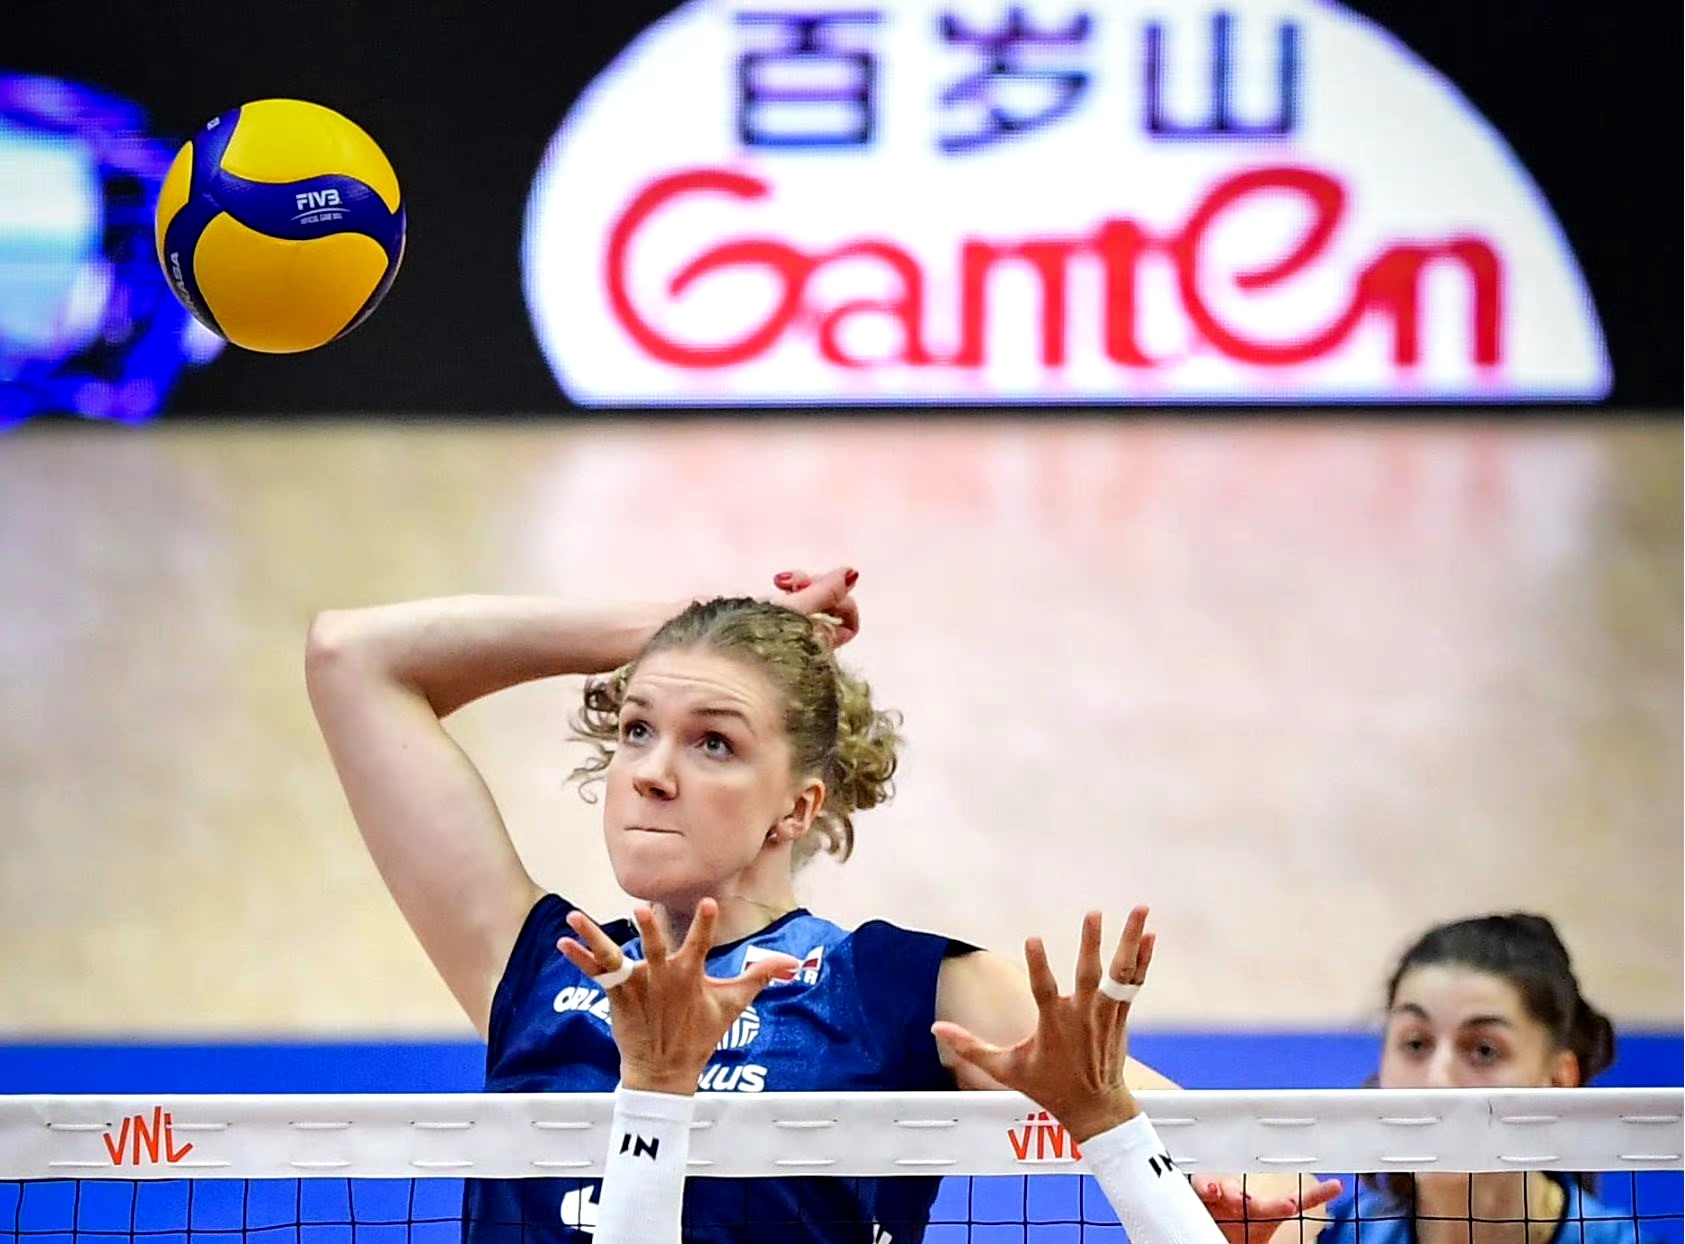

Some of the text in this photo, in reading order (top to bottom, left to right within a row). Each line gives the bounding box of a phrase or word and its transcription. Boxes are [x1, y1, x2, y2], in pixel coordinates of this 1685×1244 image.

[733, 12, 1300, 154] 百岁山
[296, 189, 340, 210] FIVB
[103, 1106, 193, 1166] VNL
[619, 1134, 659, 1161] IN
